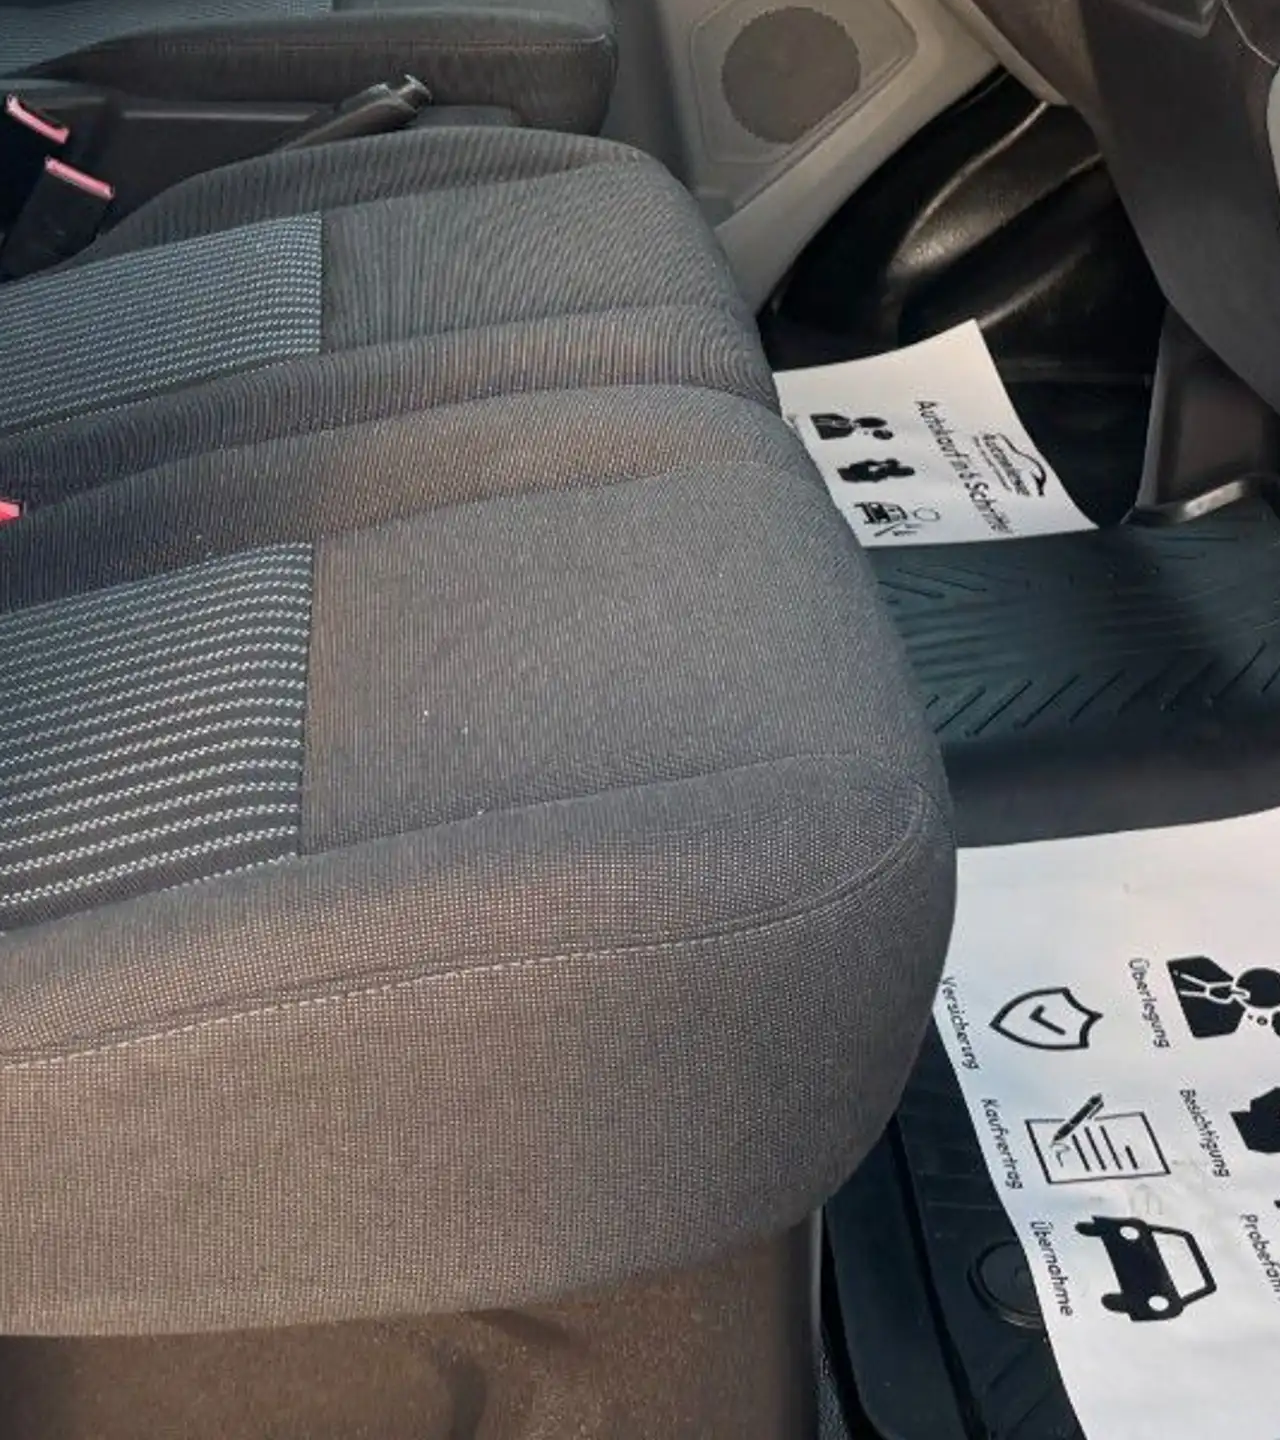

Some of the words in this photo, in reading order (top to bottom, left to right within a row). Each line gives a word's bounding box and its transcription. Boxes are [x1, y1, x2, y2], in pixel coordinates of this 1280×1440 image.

[941, 976, 980, 1069] Versicherung
[1128, 957, 1170, 1049] Überlegung
[980, 1097, 1024, 1190] Kaufvertrag
[1179, 1089, 1231, 1178] Besichtigung
[1030, 1220, 1073, 1316] Übernahme
